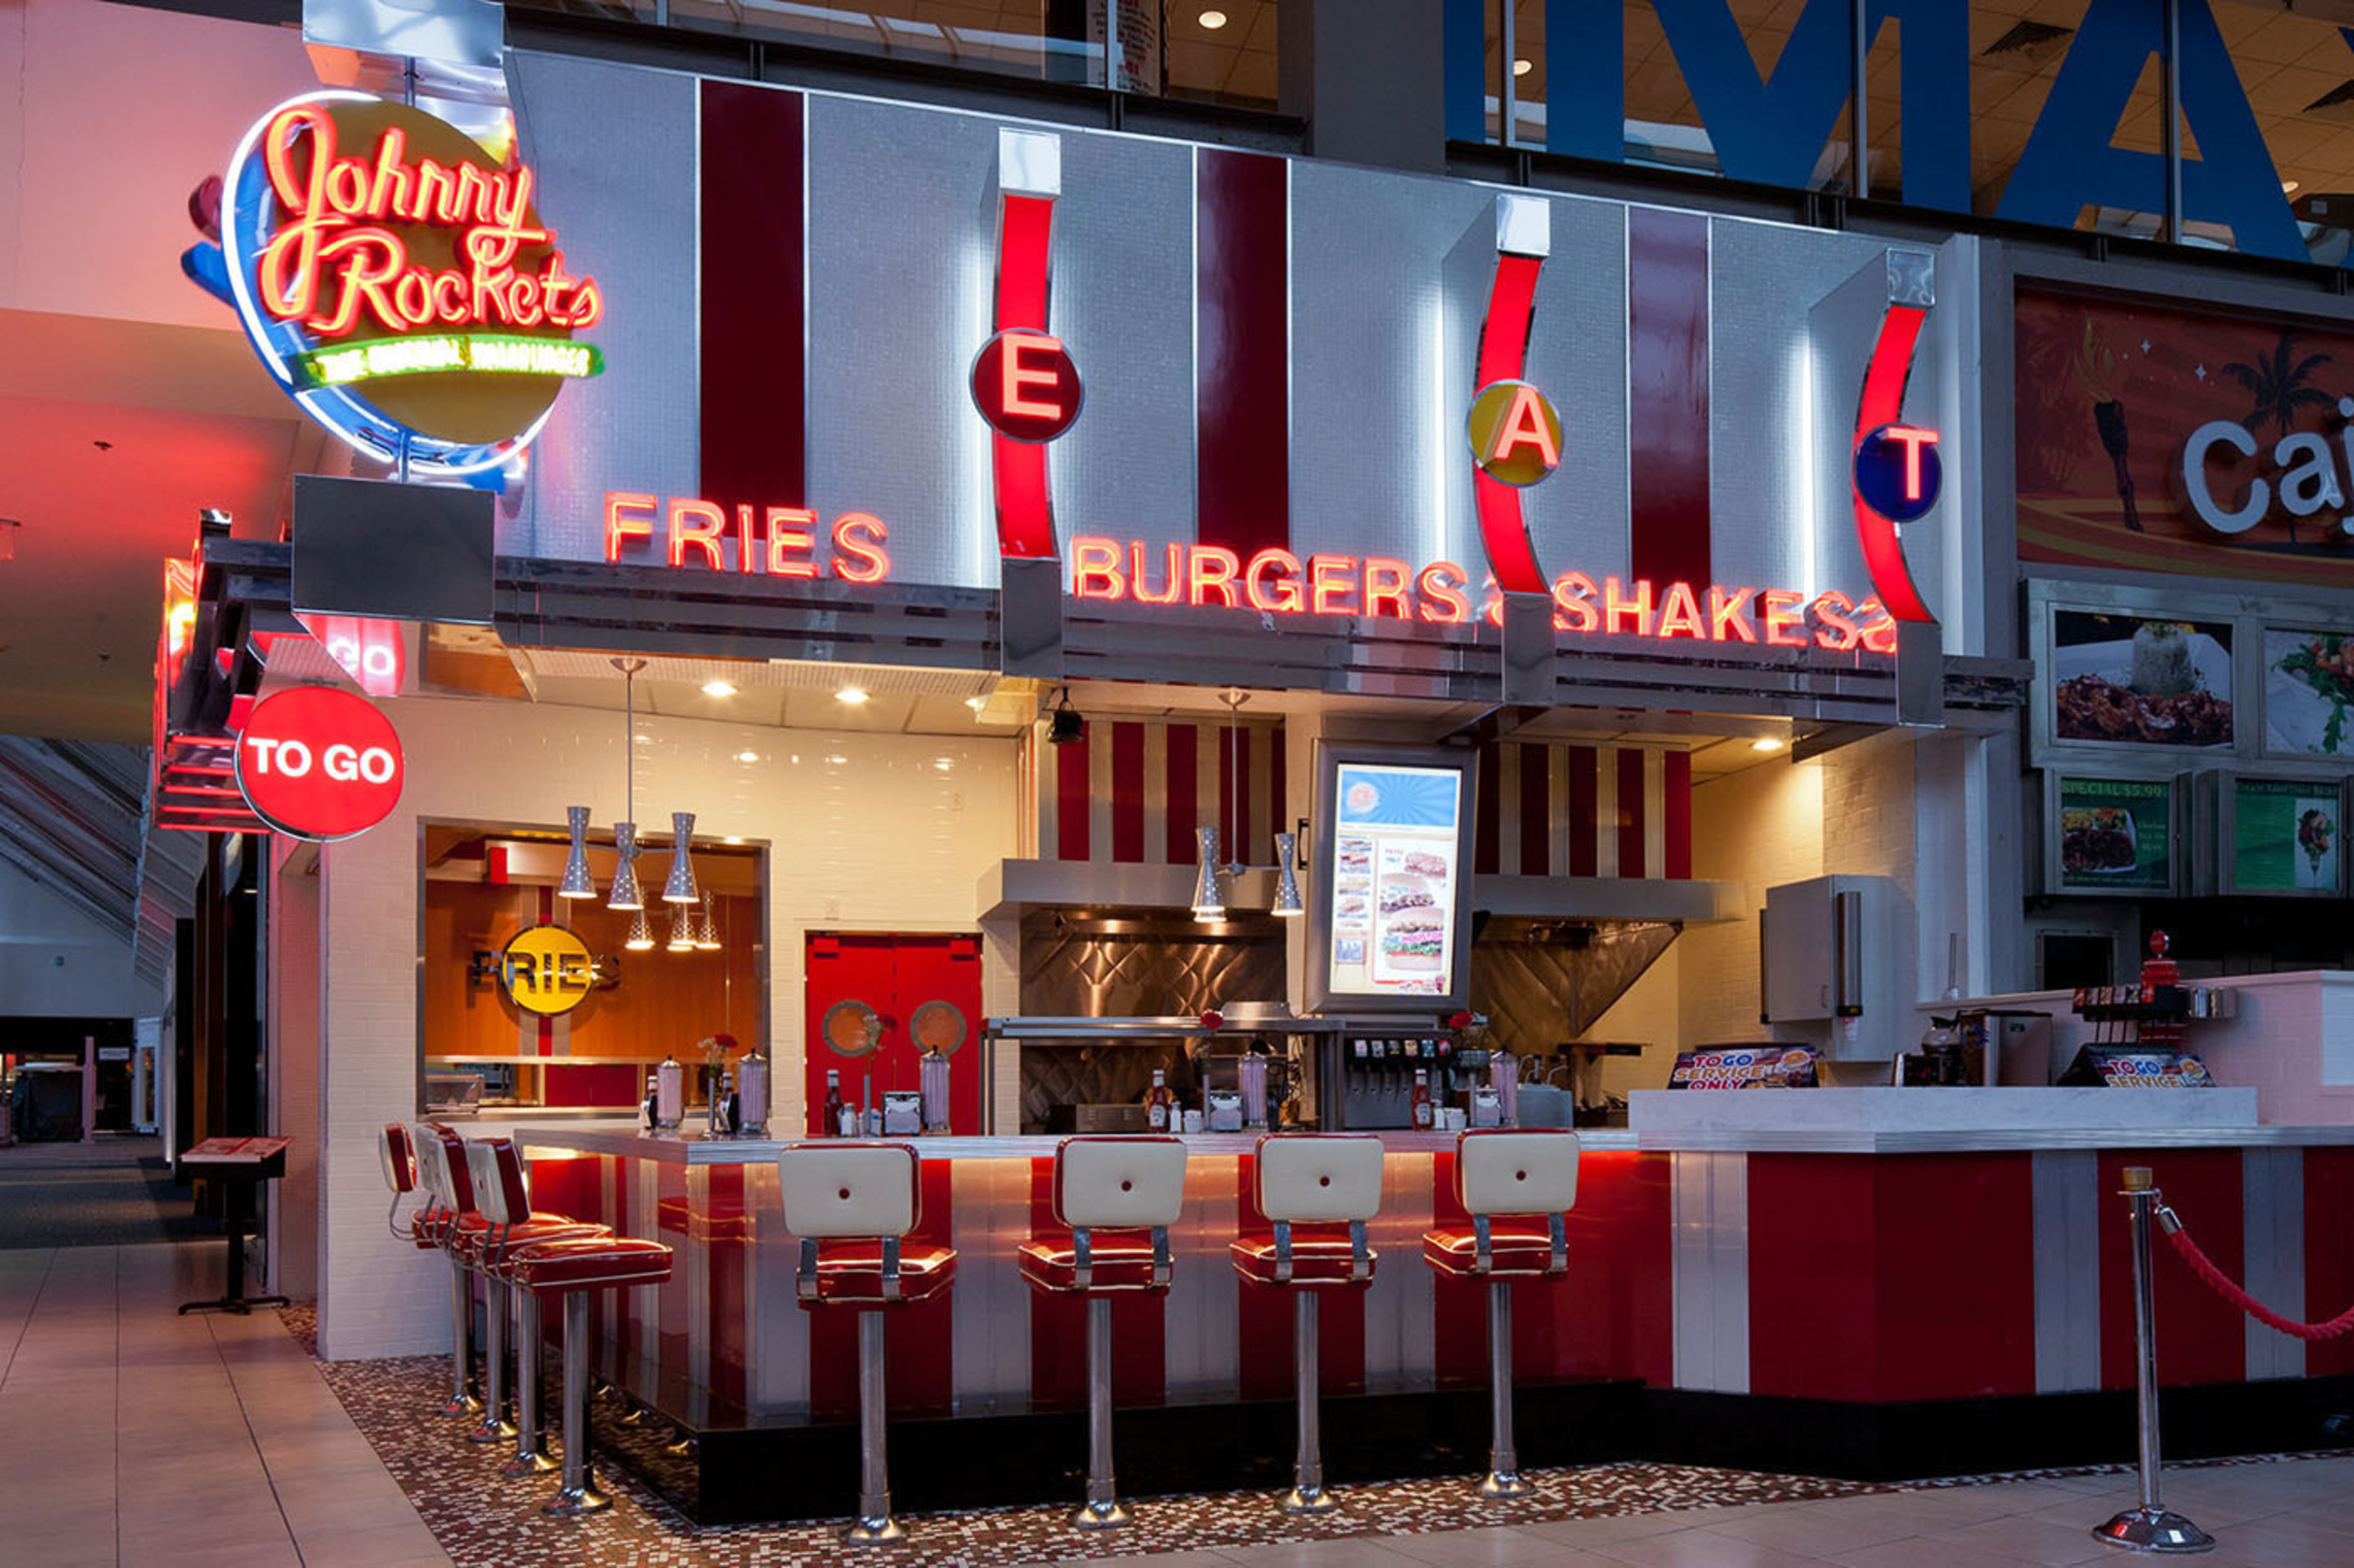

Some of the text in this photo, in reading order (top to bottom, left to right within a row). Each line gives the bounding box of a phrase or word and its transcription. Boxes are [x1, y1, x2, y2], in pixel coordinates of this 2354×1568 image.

[258, 103, 559, 321] Johnny
[308, 226, 604, 338] Rockets
[1002, 333, 1940, 501] E A T
[603, 491, 890, 583] FRIES
[1072, 535, 1471, 624] BURGERS
[1551, 571, 1858, 651] SHAKES
[246, 736, 396, 784] TO GO
[1674, 1065, 1766, 1082] SERVICE
[1689, 1078, 1745, 1089] ONLY
[2106, 1075, 2180, 1088] SERVICE
